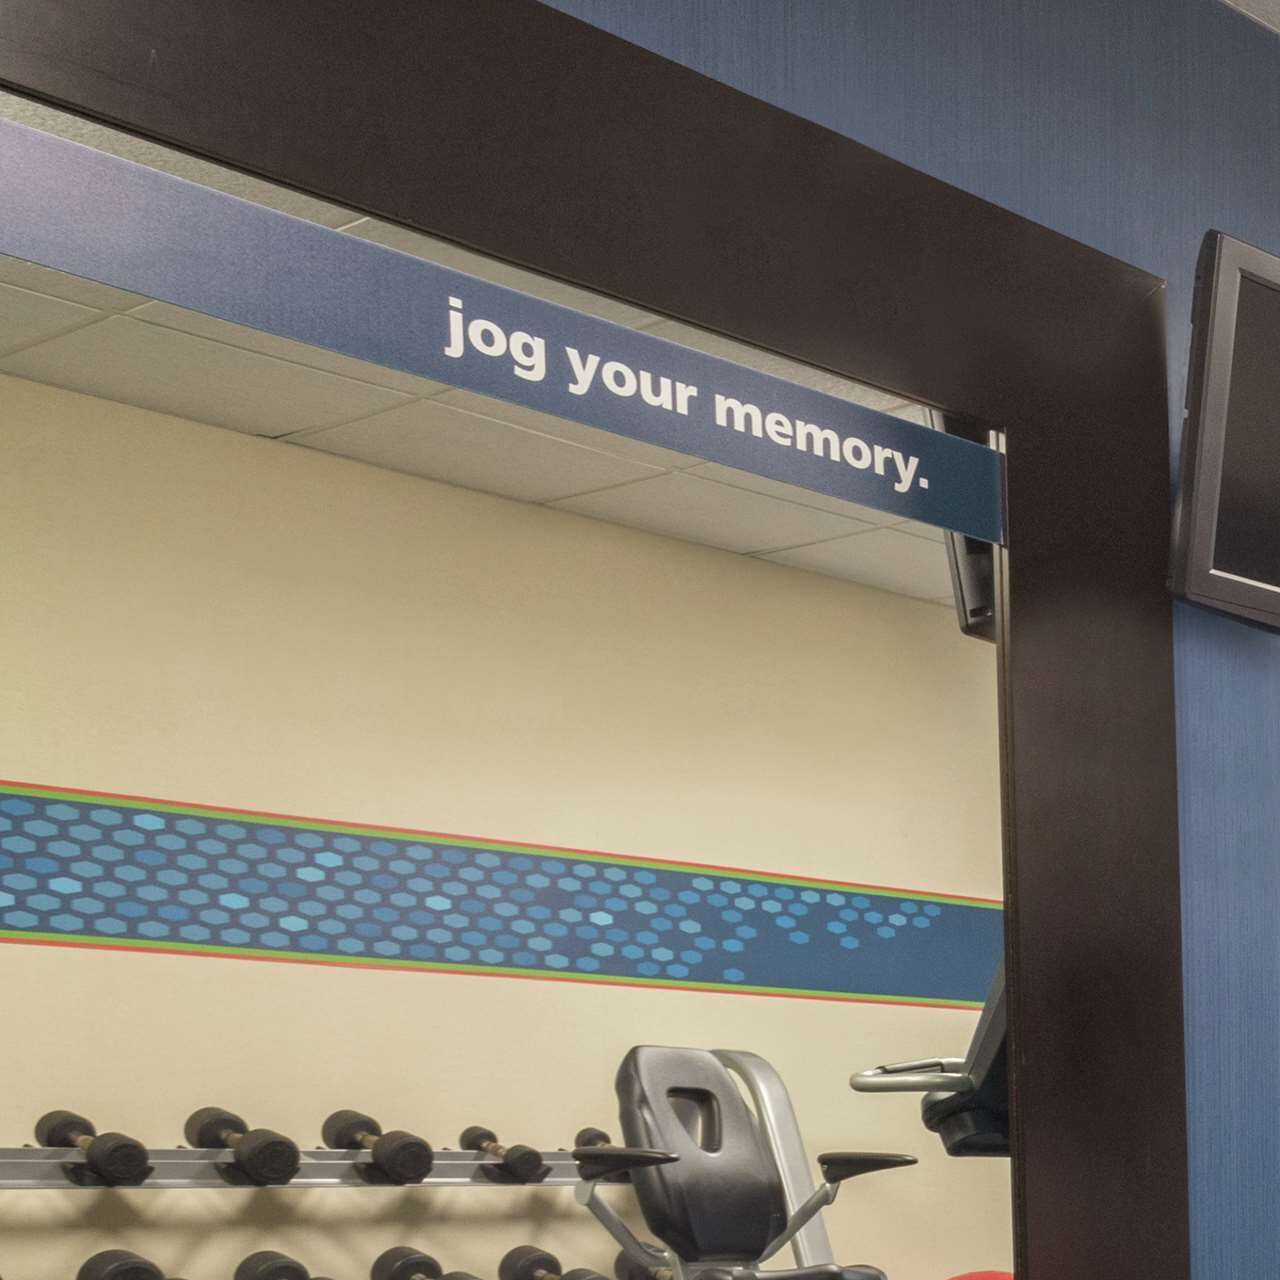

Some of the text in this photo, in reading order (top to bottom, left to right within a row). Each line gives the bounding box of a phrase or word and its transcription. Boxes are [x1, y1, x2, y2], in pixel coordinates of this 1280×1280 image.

[444, 296, 930, 494] jog your memory.
